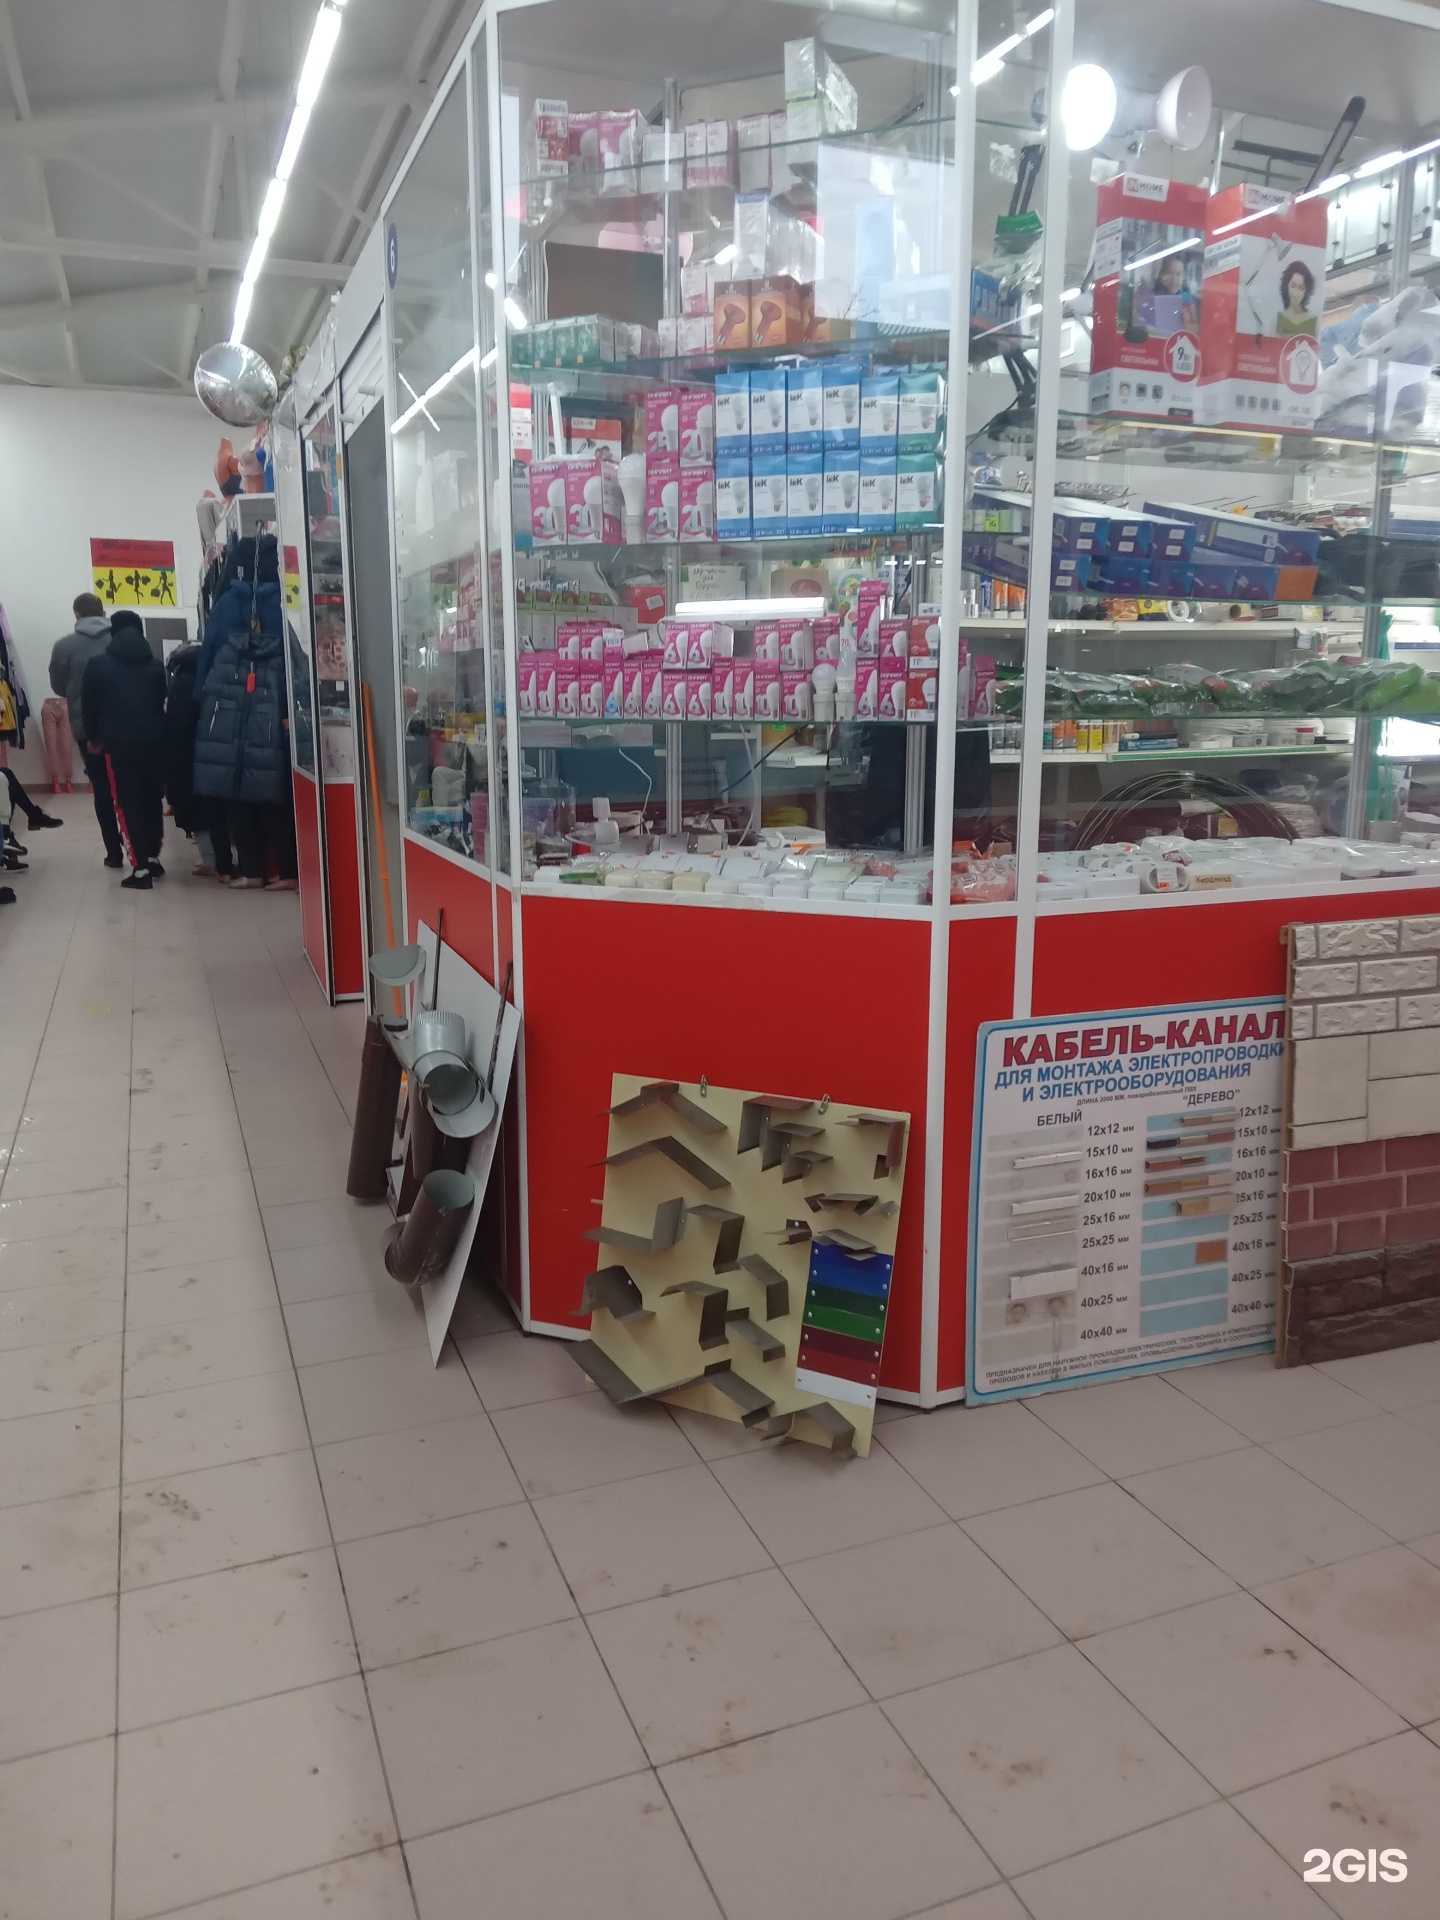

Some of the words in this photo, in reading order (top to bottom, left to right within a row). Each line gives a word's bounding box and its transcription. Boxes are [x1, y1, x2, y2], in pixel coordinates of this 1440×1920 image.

[1002, 1010, 1286, 1067] КАБЕЛЬ-КАНАЛ
[994, 1069, 1032, 1090] ДЛЯ
[1037, 1059, 1124, 1083] МОНТАЖА
[1022, 1086, 1034, 1103] И
[1039, 1062, 1252, 1100] ЭЛЕКТРООБОРУДОВАНИЯ
[1037, 1109, 1082, 1126] БЕЛЫЙ
